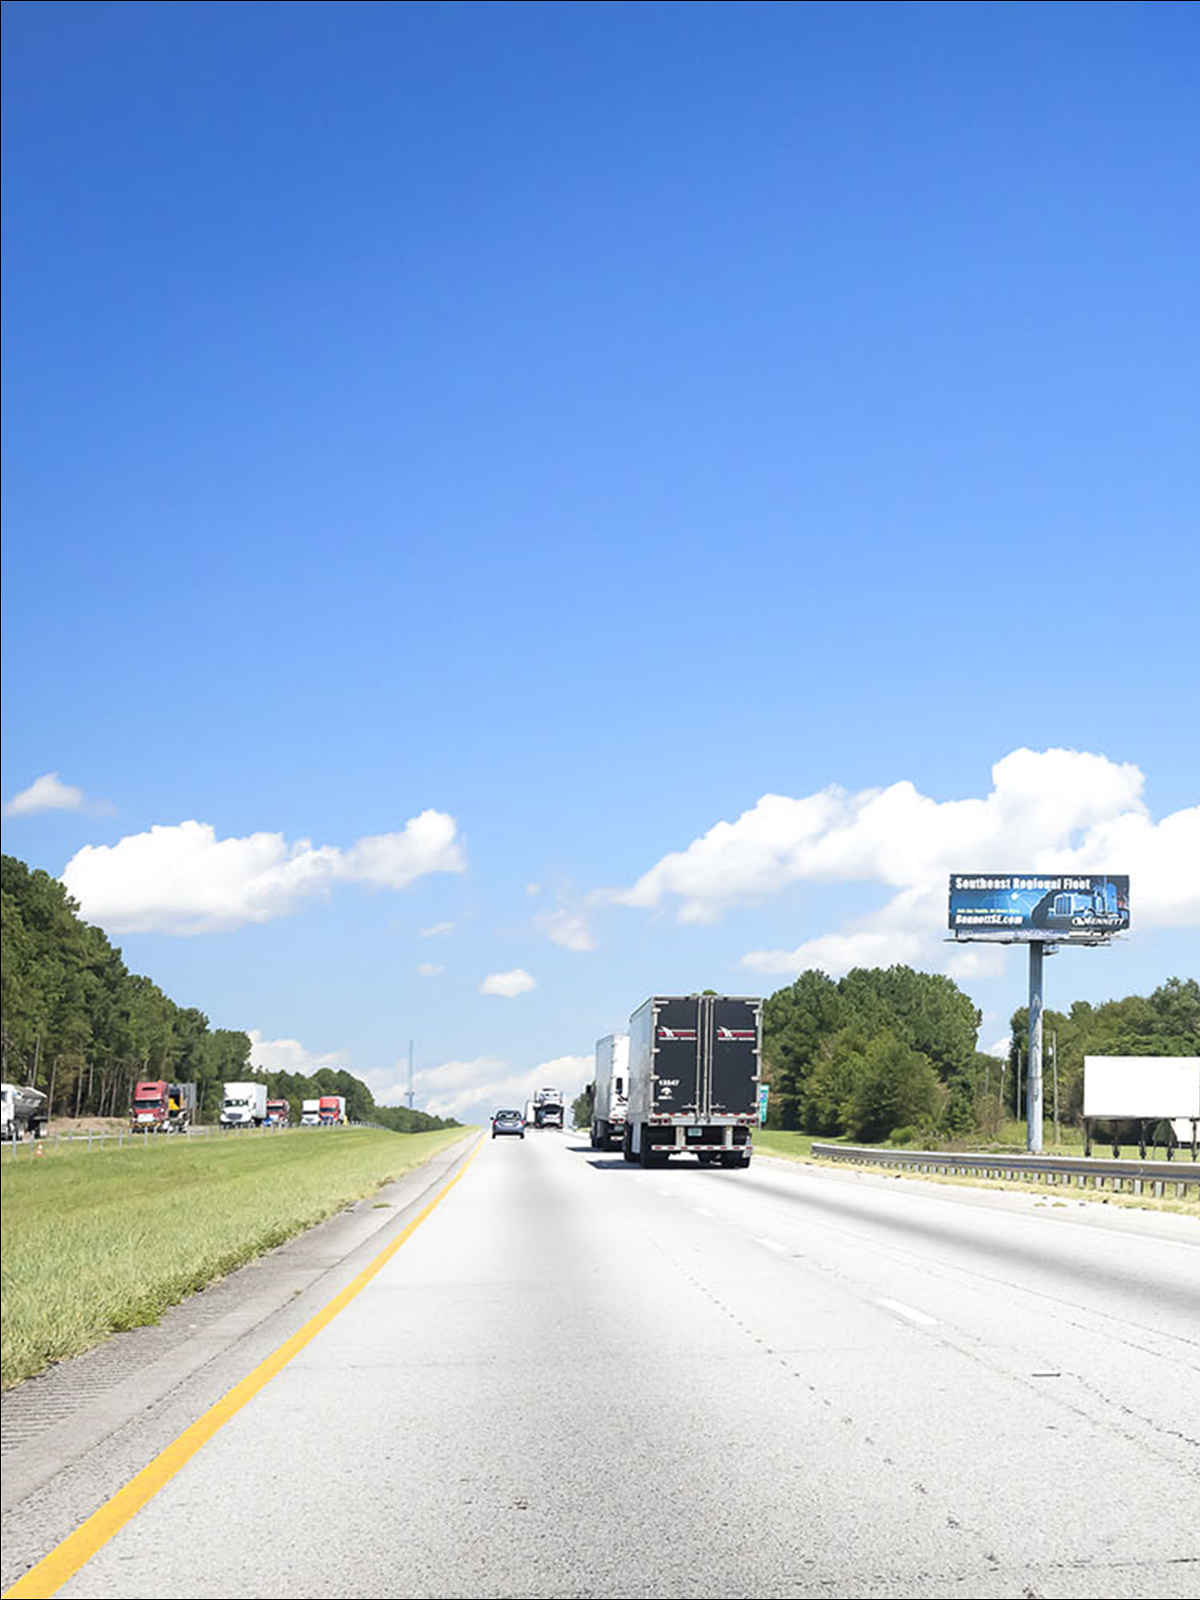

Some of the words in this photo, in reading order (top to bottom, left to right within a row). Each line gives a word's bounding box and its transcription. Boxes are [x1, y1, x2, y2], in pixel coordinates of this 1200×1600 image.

[955, 877, 1011, 890] Southeast
[1012, 877, 1061, 890] Regional
[1063, 878, 1090, 890] Fleet
